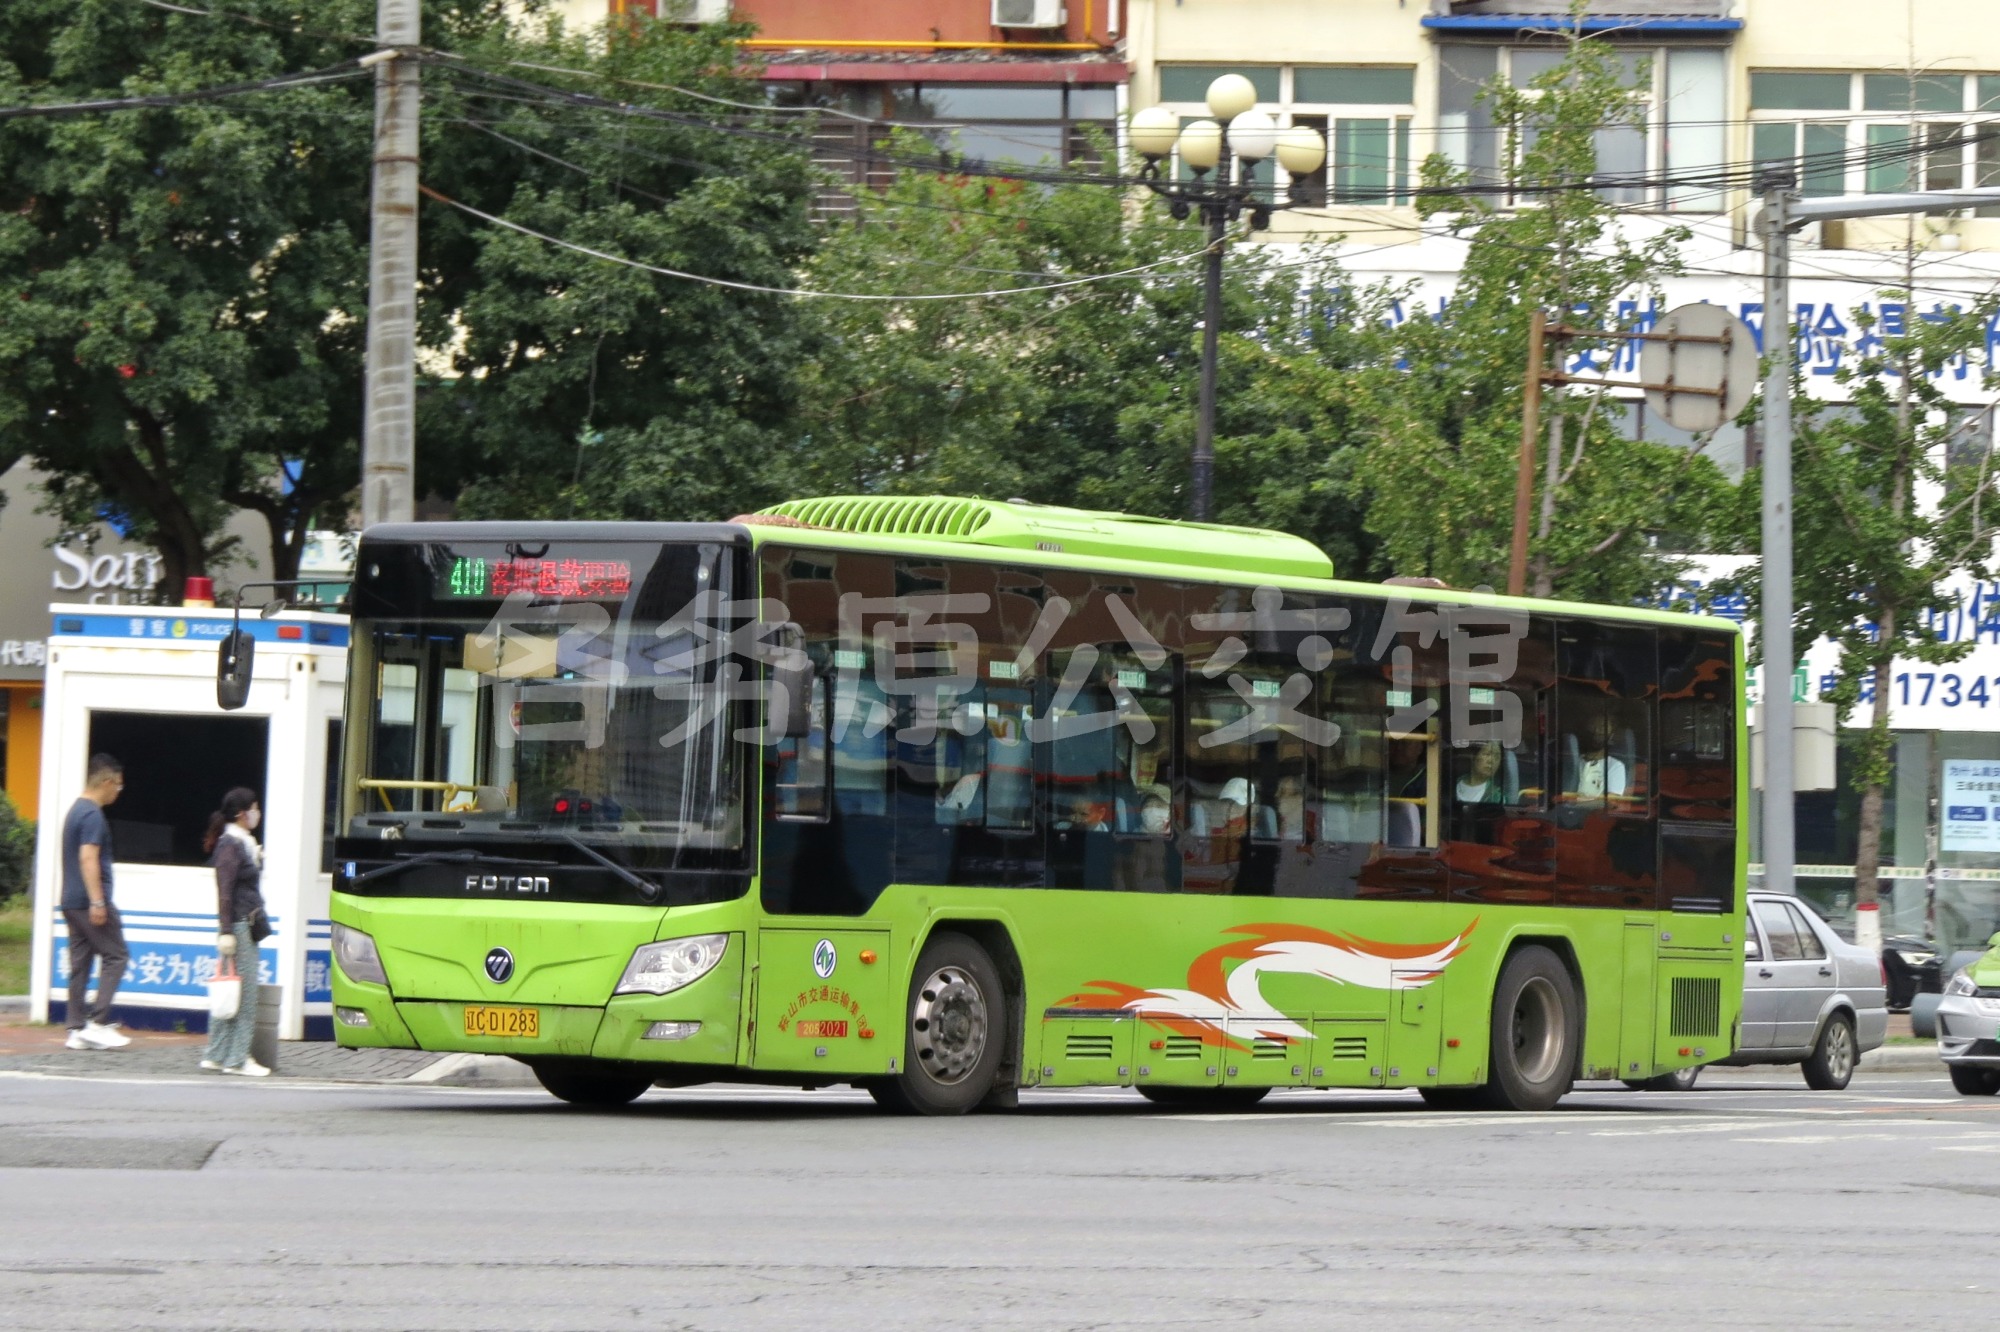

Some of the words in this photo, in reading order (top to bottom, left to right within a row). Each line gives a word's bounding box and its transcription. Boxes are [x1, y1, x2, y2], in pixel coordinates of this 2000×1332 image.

[451, 557, 485, 595] 410
[191, 623, 233, 636] POLICE
[466, 875, 550, 893] FOTON
